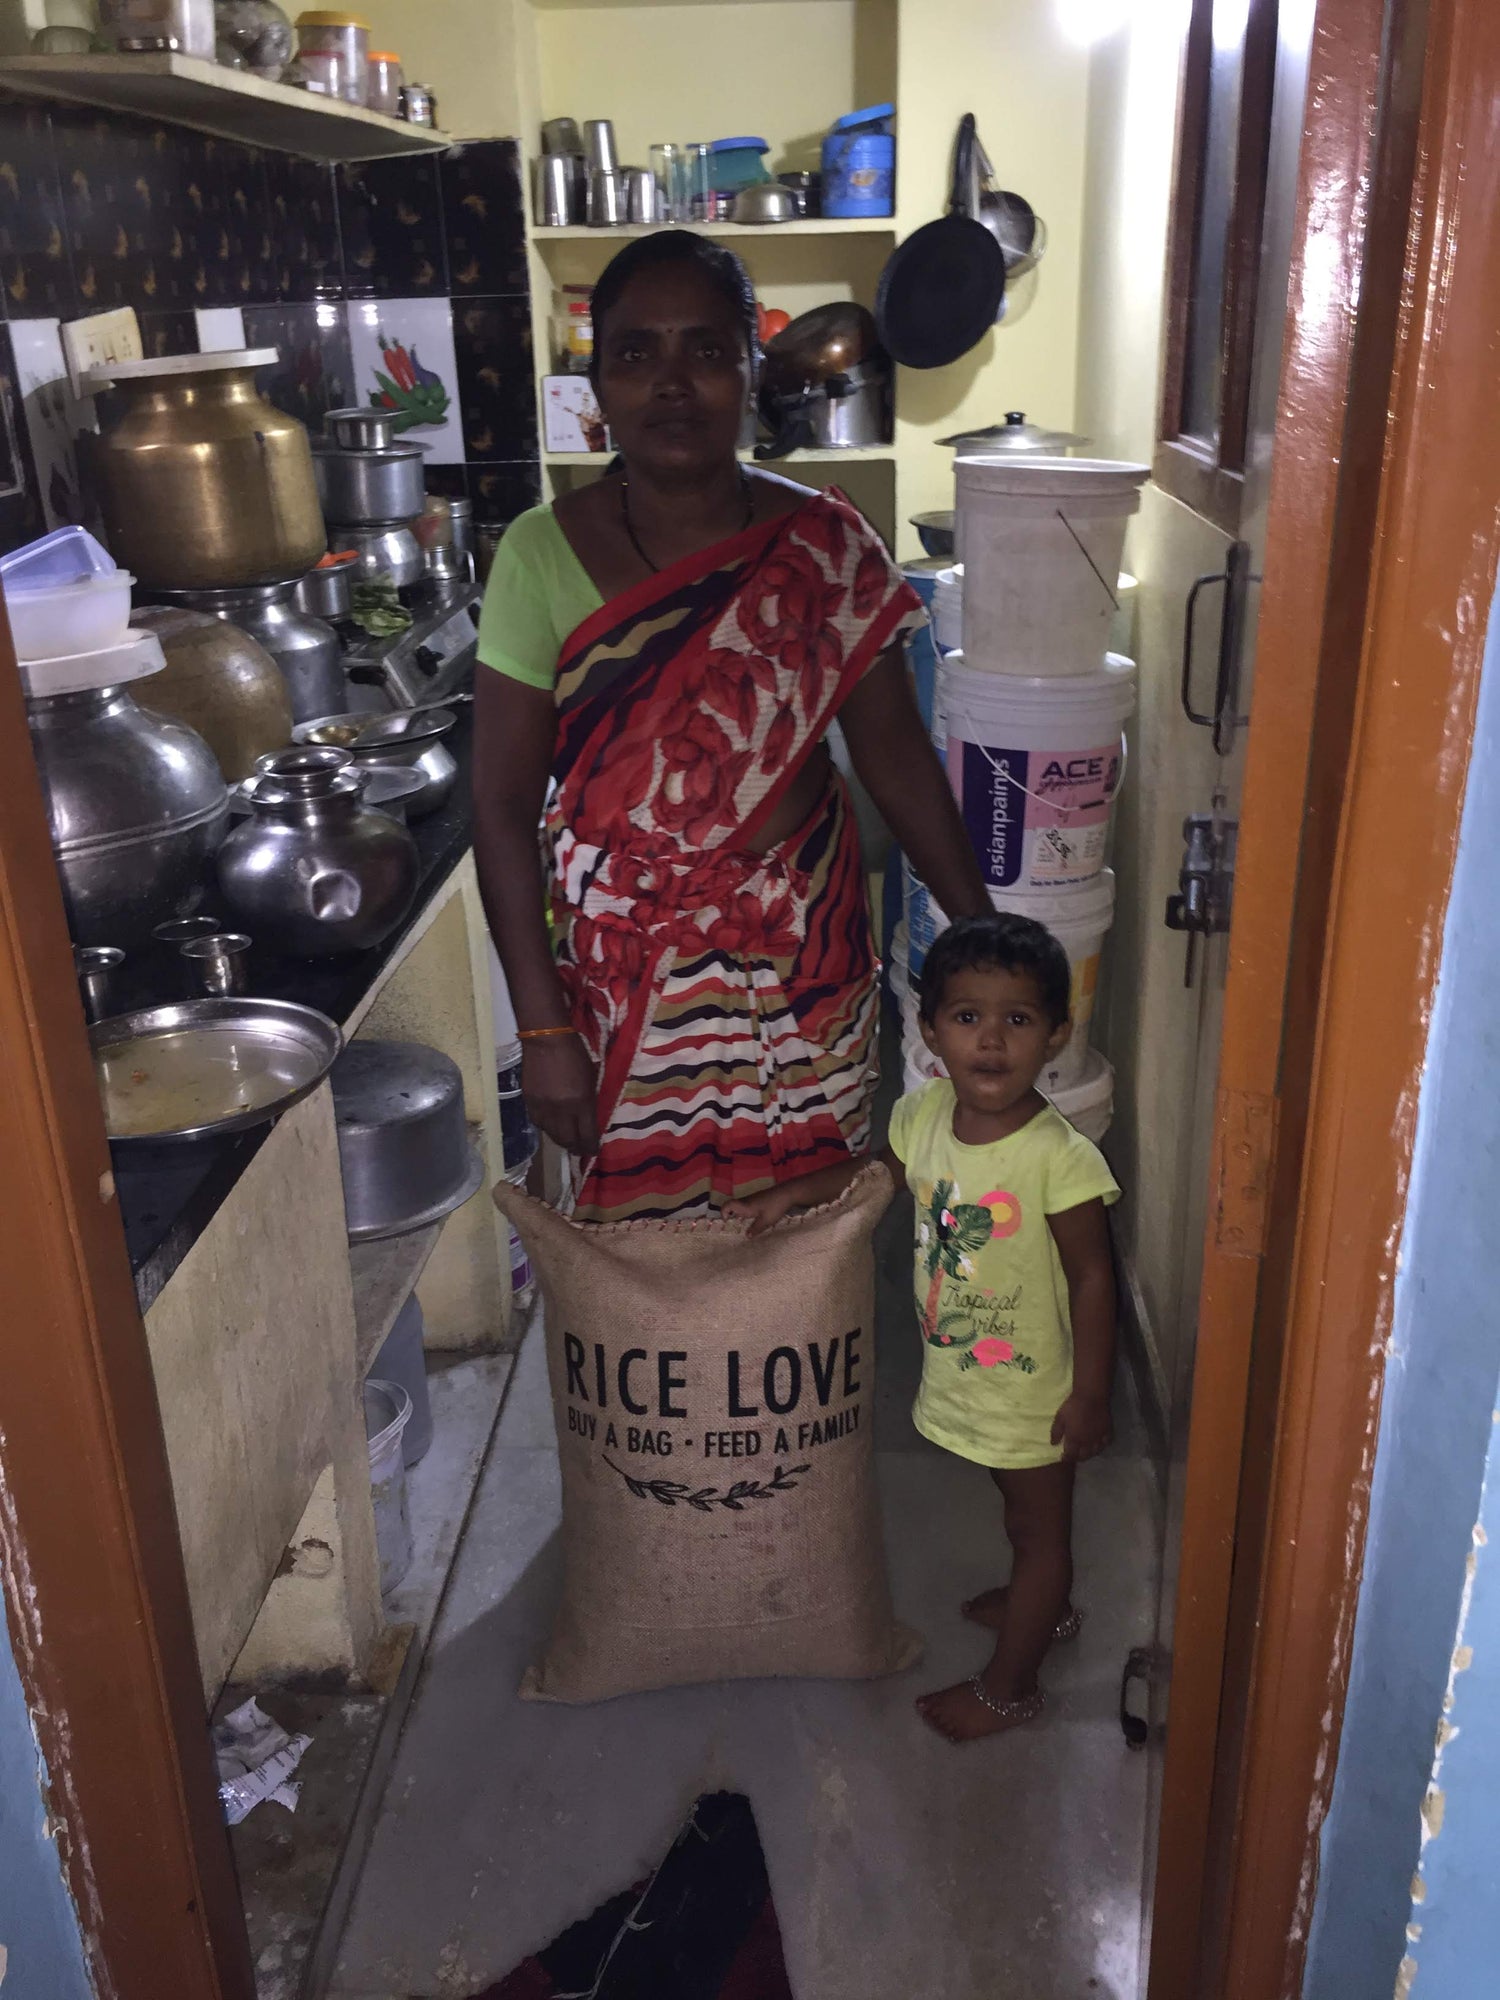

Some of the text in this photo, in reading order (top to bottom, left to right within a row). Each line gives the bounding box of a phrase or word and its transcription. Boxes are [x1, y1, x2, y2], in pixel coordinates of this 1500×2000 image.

[1041, 756, 1104, 780] ACE
[986, 757, 1016, 877] asianpaints
[564, 1327, 862, 1418] RICE LOVE
[567, 1404, 860, 1457] BUY A BAG FEED A FAMILY
